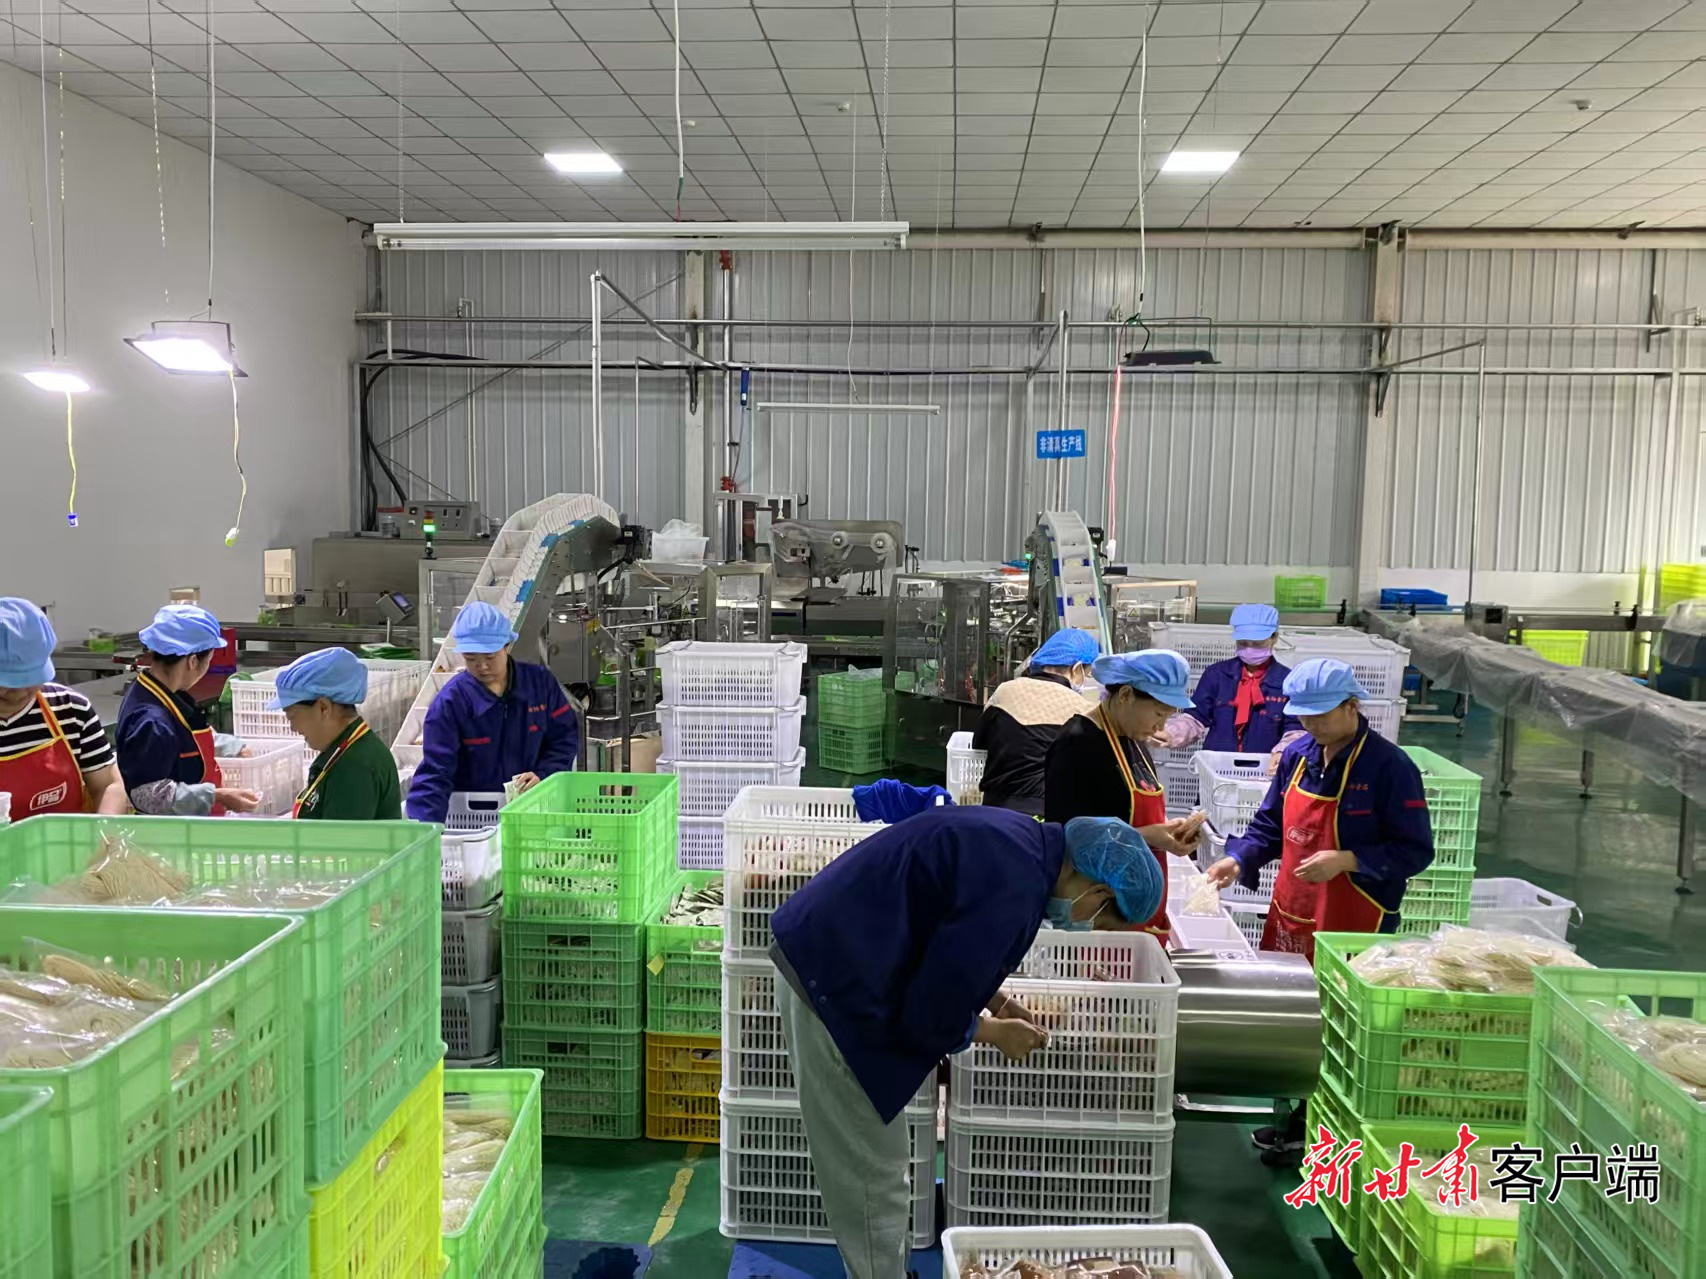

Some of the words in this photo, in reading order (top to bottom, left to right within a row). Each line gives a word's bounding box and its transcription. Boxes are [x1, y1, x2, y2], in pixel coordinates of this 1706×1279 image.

[1040, 435, 1083, 453] 非清真生产线
